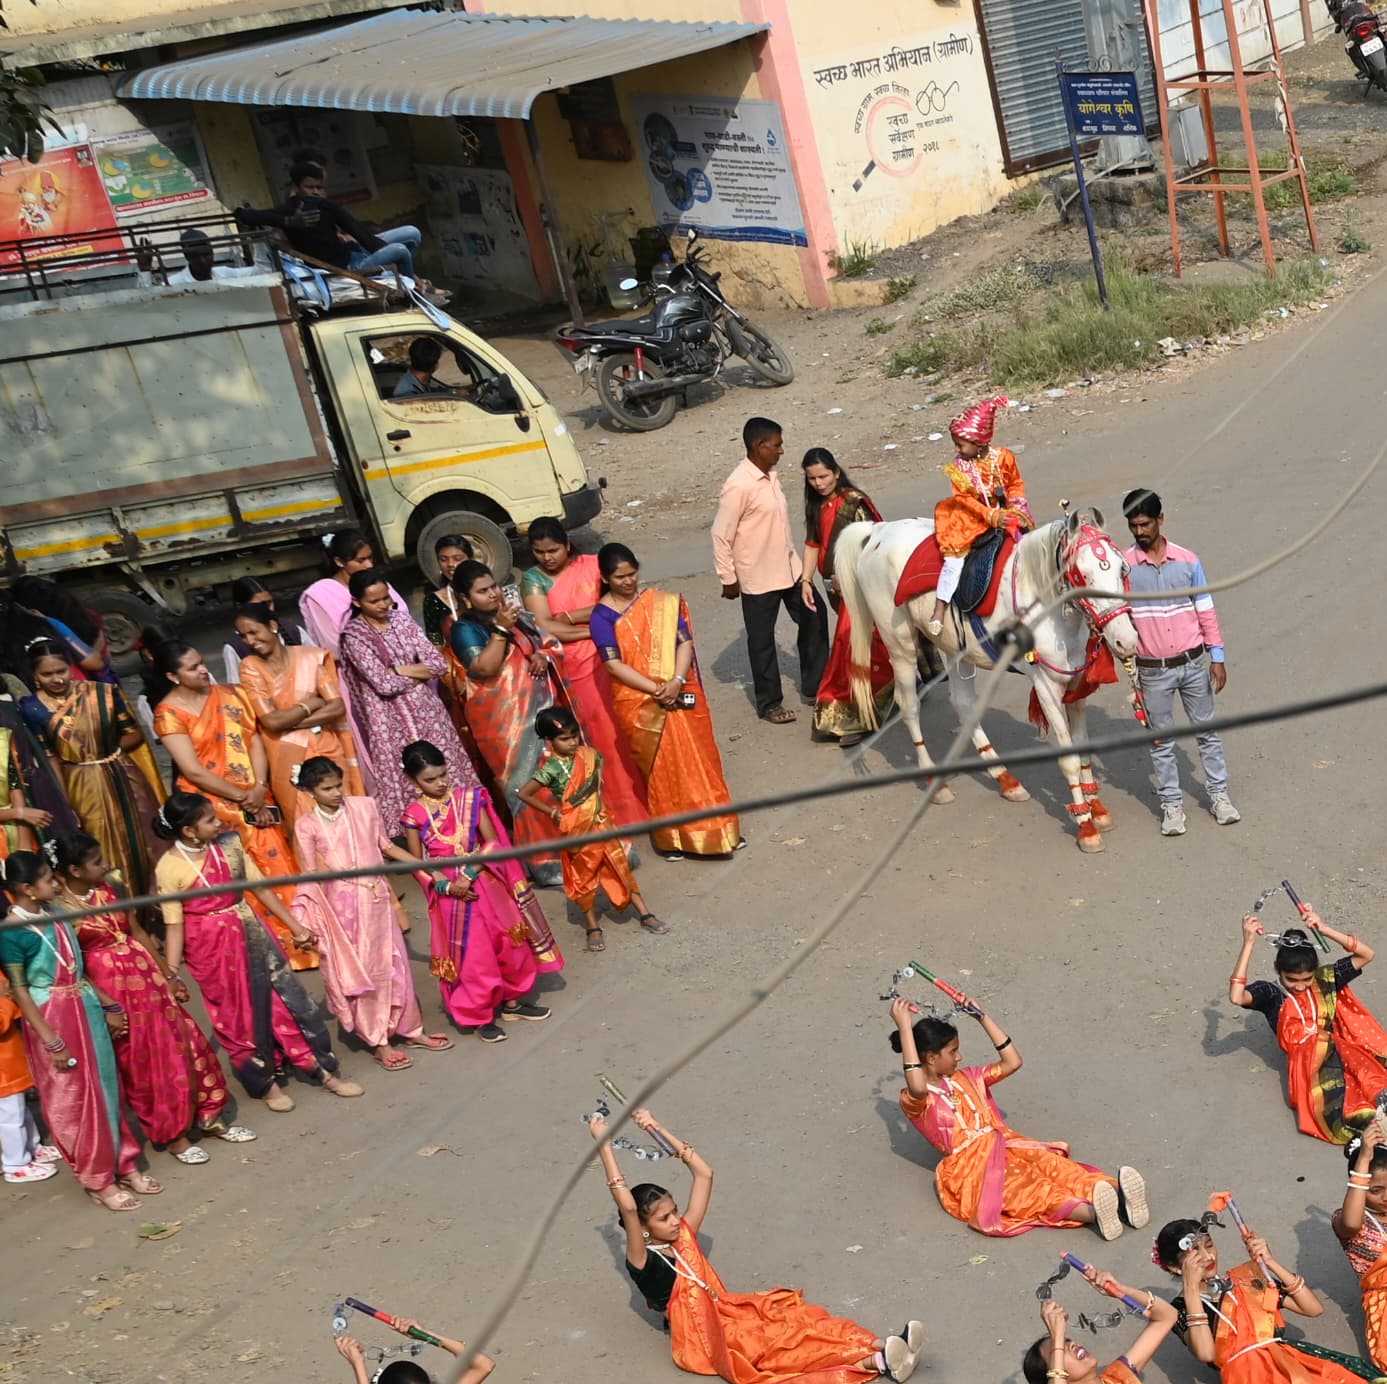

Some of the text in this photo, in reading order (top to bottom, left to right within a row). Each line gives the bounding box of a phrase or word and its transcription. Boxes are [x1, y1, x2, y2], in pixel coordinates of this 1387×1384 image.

[813, 33, 974, 90] स्वच्छ भारत अभियान (ग्रामीण)
[1077, 99, 1135, 120] योगेश्वर कृषि
[886, 113, 909, 128] स्वच्छ
